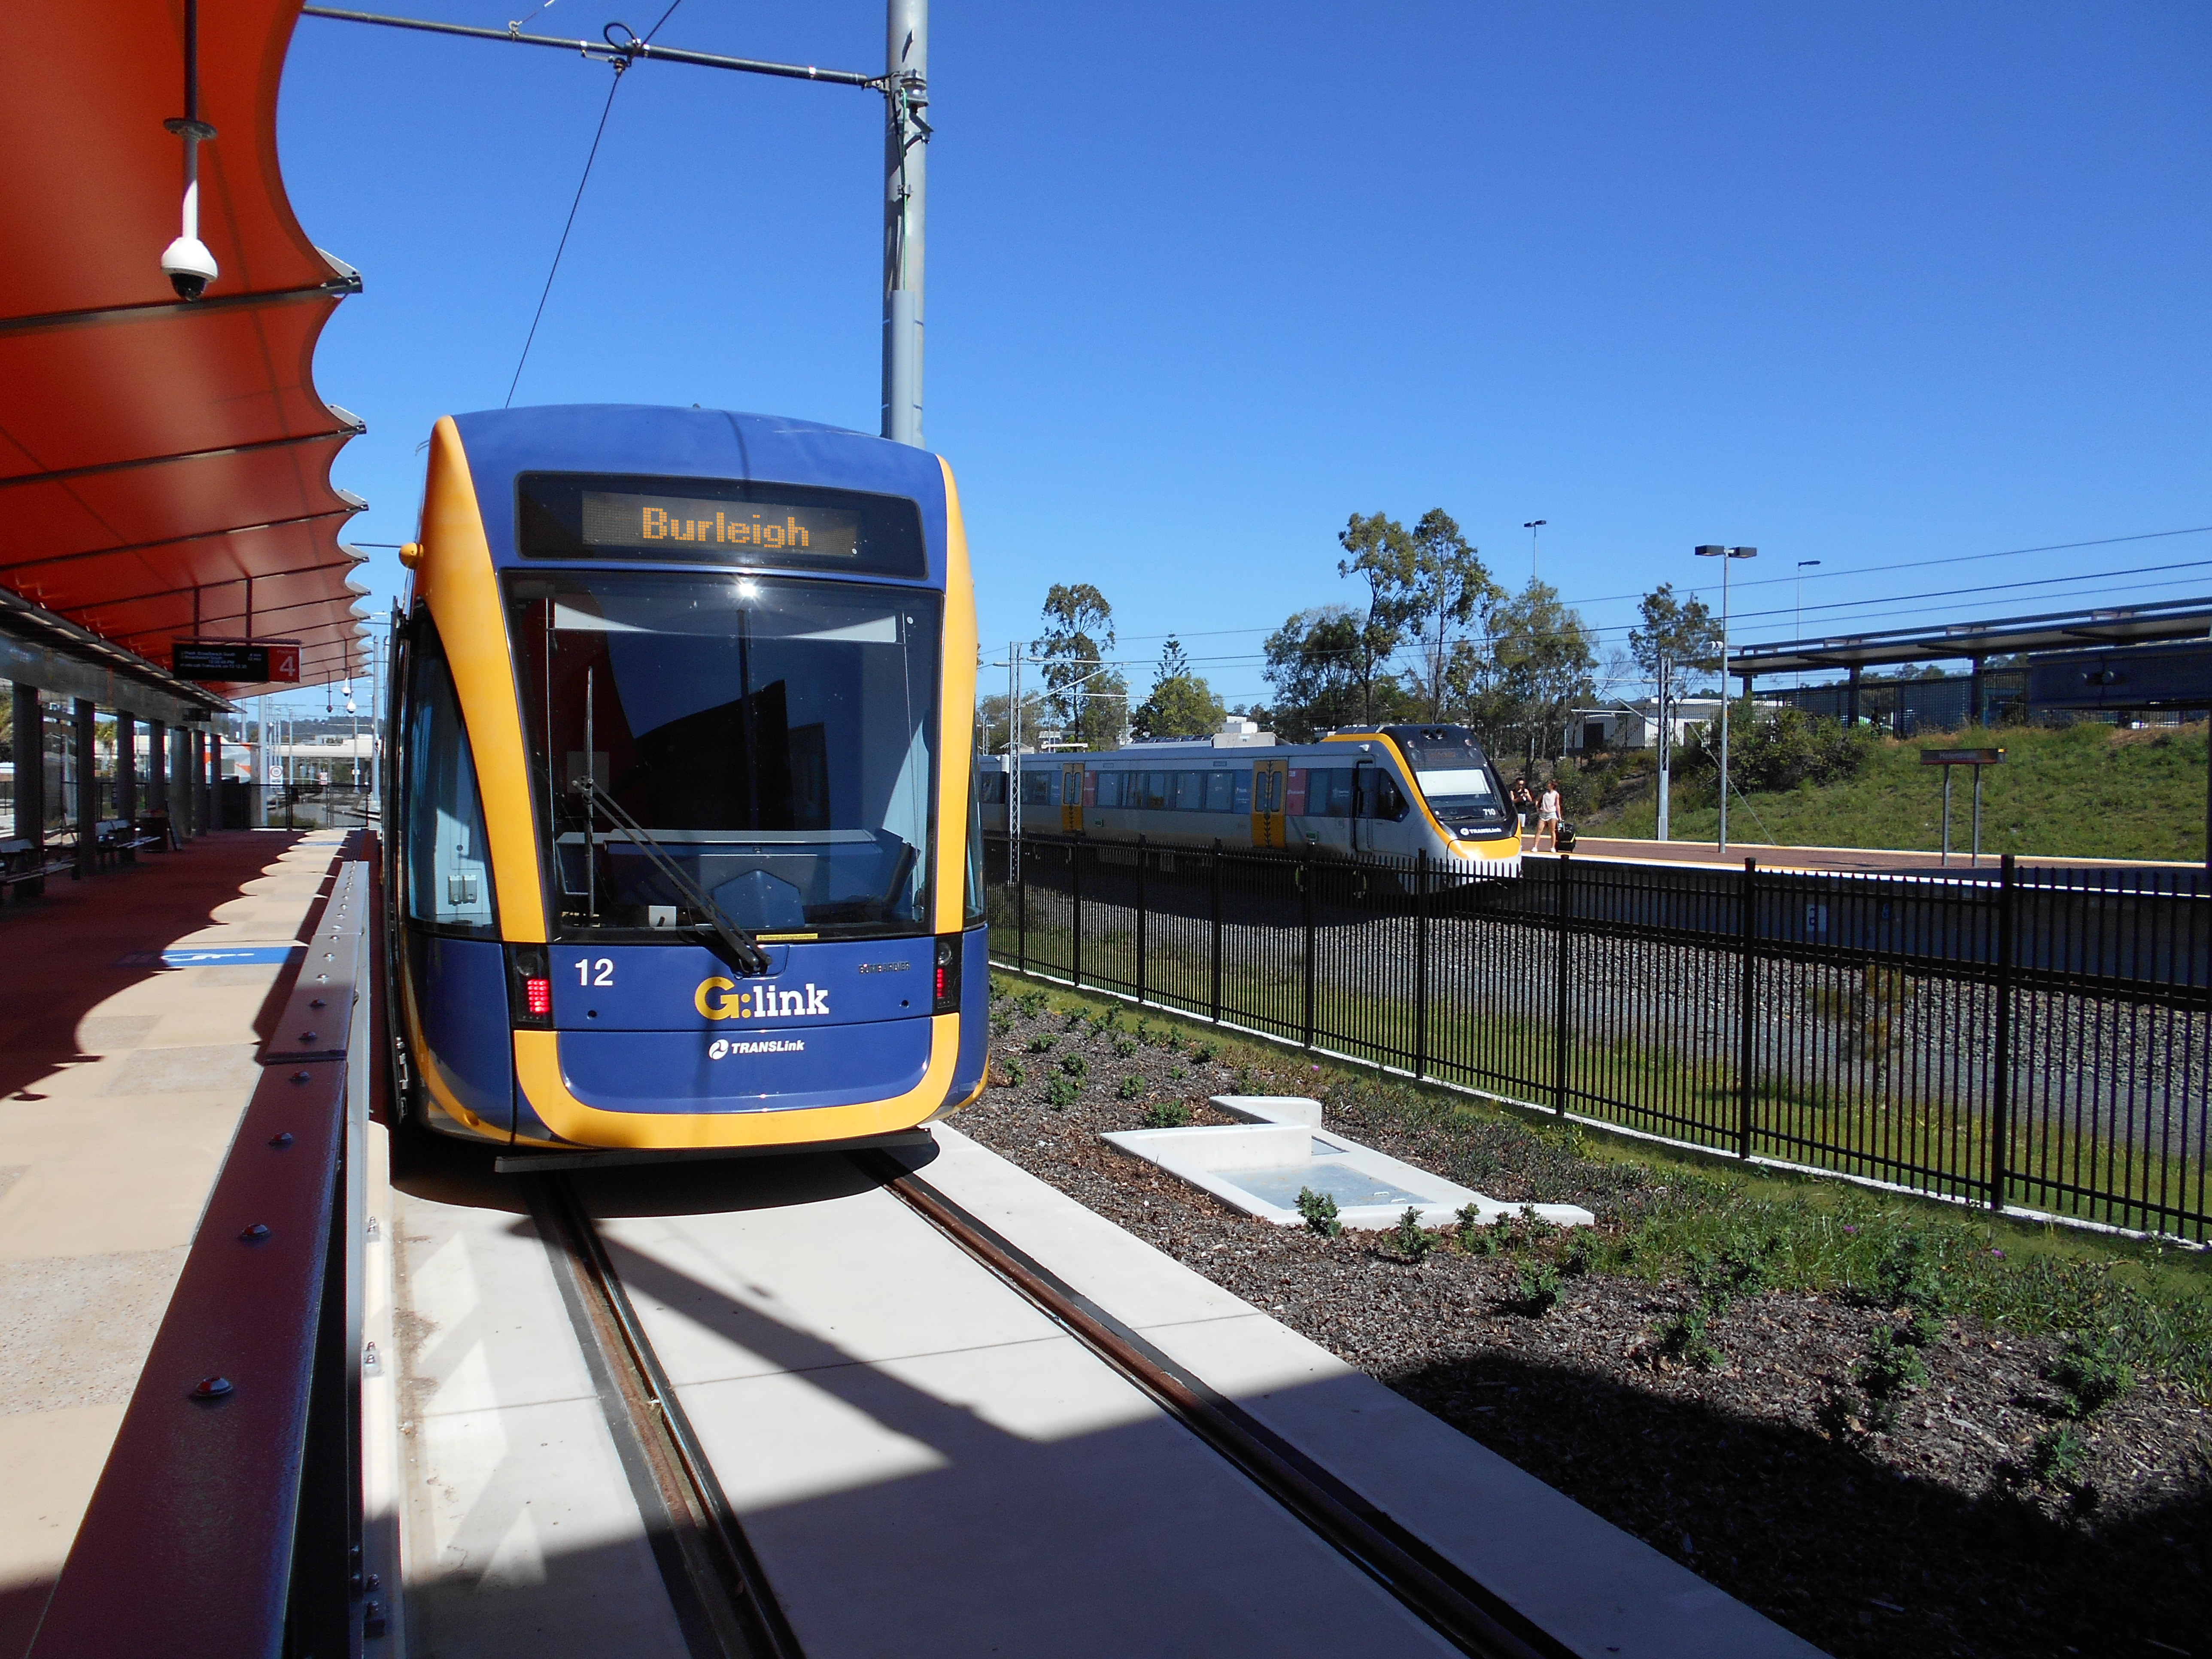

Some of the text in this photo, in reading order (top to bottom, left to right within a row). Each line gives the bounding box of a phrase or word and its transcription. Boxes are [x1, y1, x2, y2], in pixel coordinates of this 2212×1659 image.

[643, 507, 808, 548] Burleigh
[280, 656, 295, 677] 4
[575, 958, 613, 986] 12
[858, 961, 910, 974] BOMBARDIER
[695, 976, 830, 1020] G:link
[731, 1039, 805, 1054] TRANSLink
